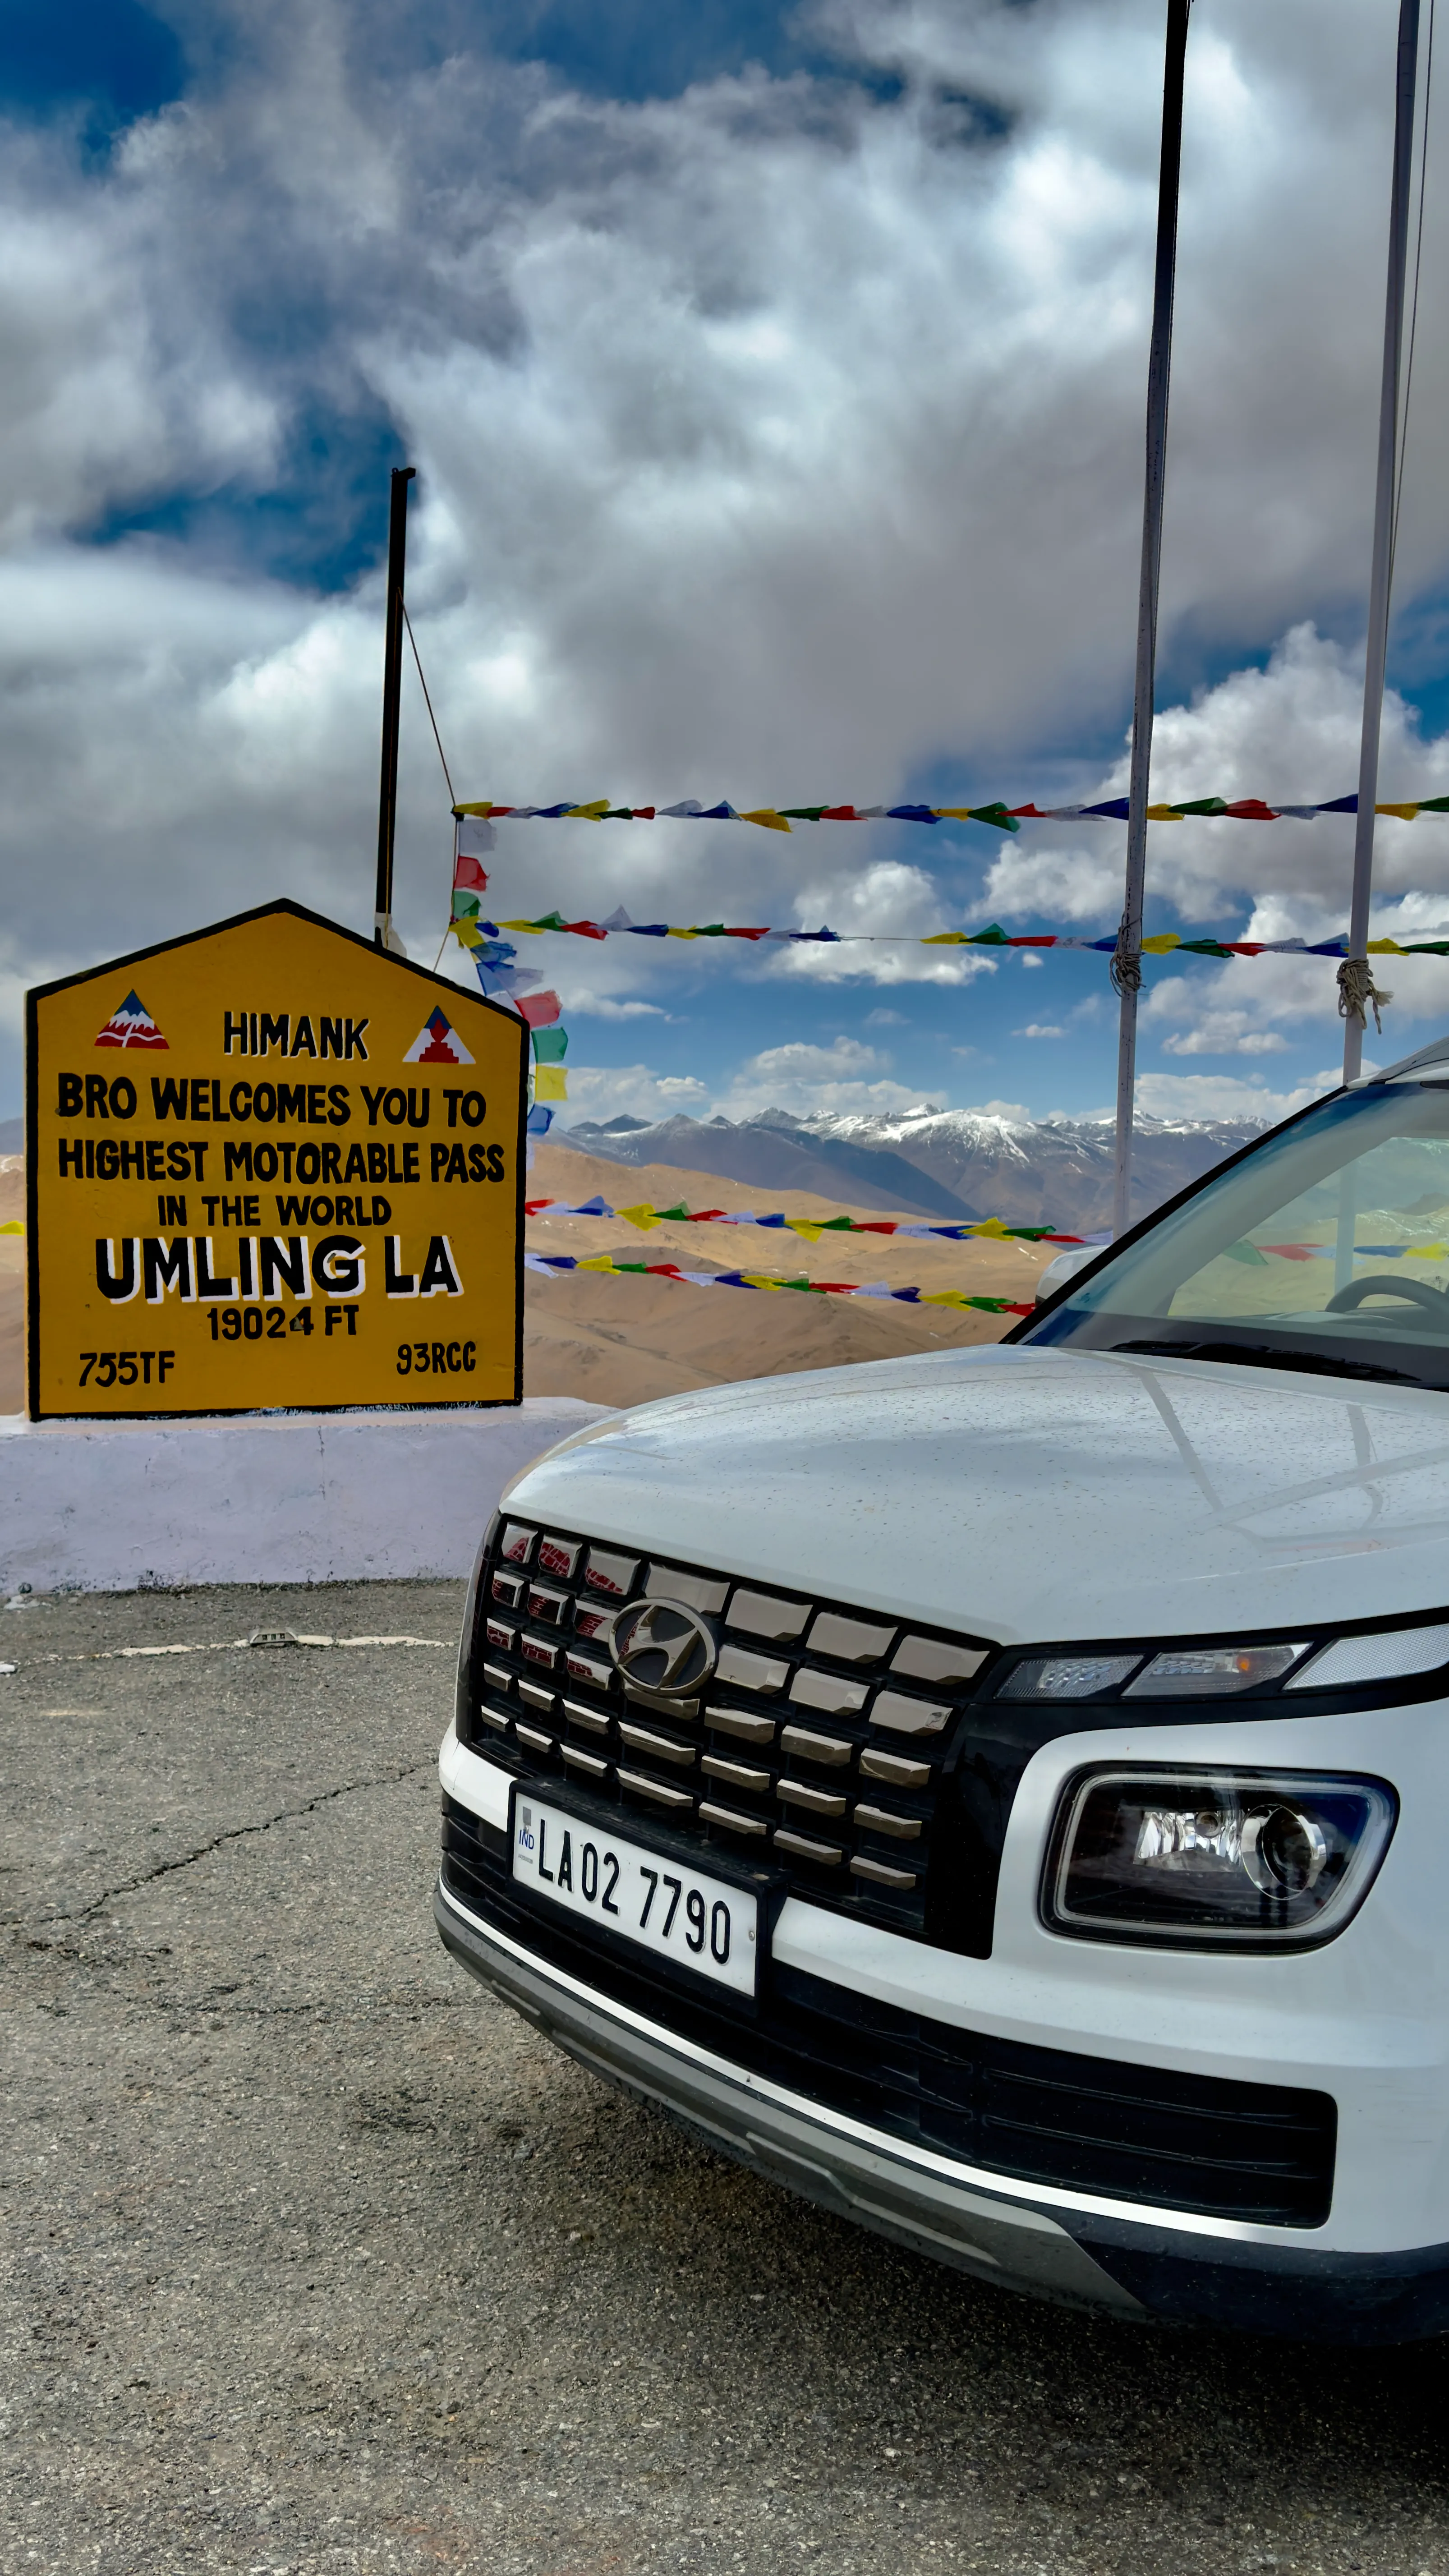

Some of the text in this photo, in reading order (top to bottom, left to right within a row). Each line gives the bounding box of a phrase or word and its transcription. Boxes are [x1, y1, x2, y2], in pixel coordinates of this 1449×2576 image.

[224, 1011, 370, 1060] HIMANK
[58, 1072, 487, 1128] BRO WELCOMES YOU TO
[58, 1138, 505, 1185] HIGHEST MOTORABLE PASS
[157, 1195, 392, 1227] IN THE WORLD
[95, 1235, 464, 1303] UMLING LA
[207, 1304, 359, 1341] 19024 FT
[78, 1350, 175, 1388] 755TF
[396, 1341, 476, 1375] 93RCC
[519, 1829, 534, 1849] IND
[538, 1818, 731, 1965] LA02 7790
